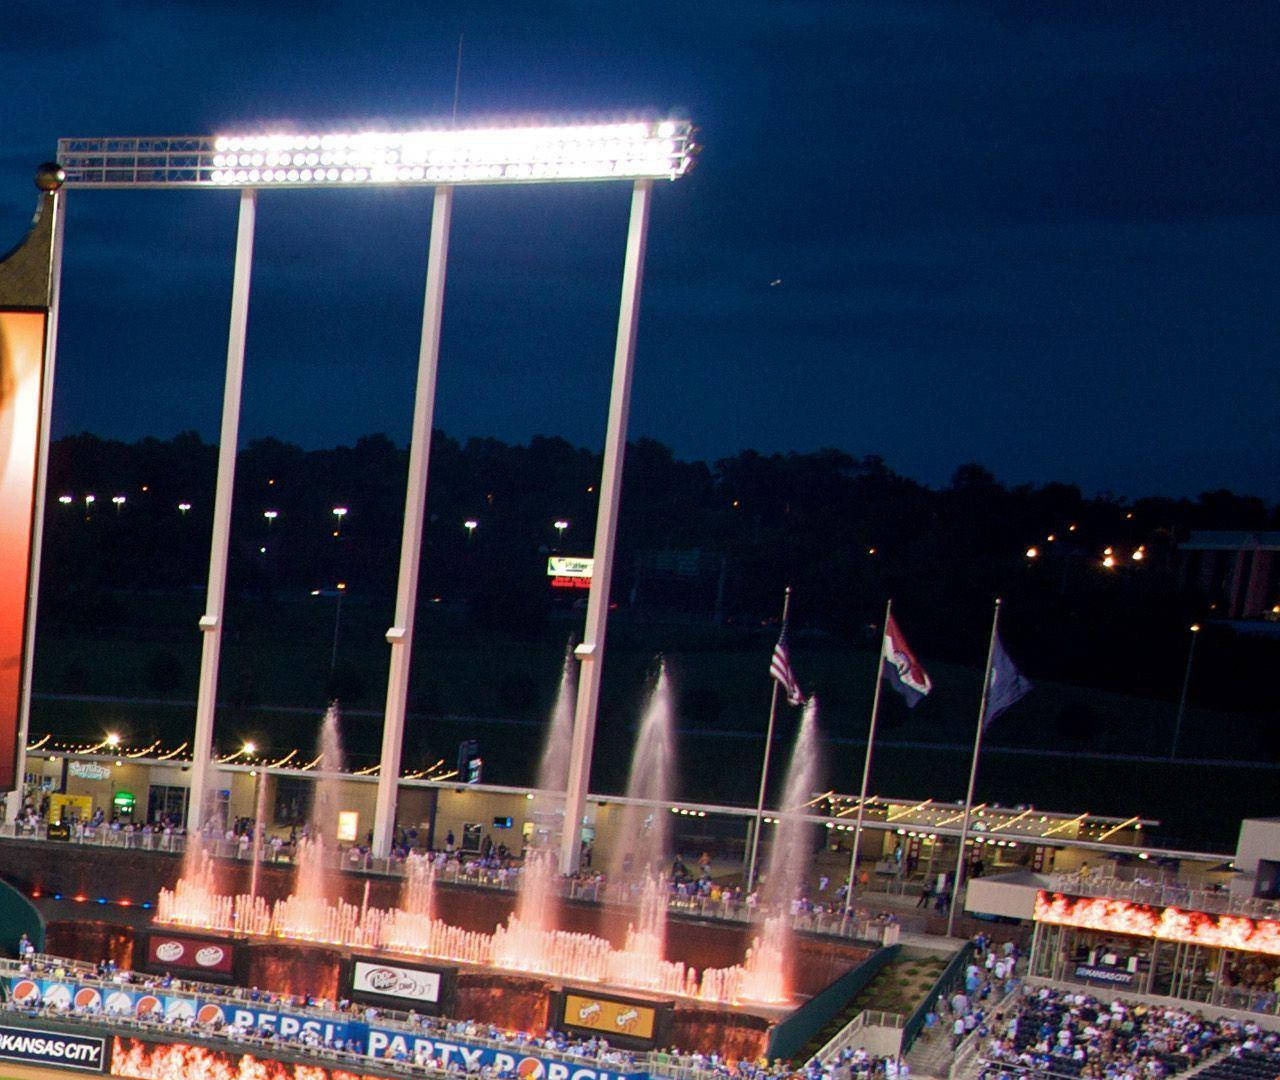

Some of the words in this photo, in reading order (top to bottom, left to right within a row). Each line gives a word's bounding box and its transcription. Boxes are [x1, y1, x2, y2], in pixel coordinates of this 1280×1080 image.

[0, 1033, 66, 1058] KANSAS
[64, 1043, 101, 1062] CITY
[367, 1030, 484, 1072] PARTY
